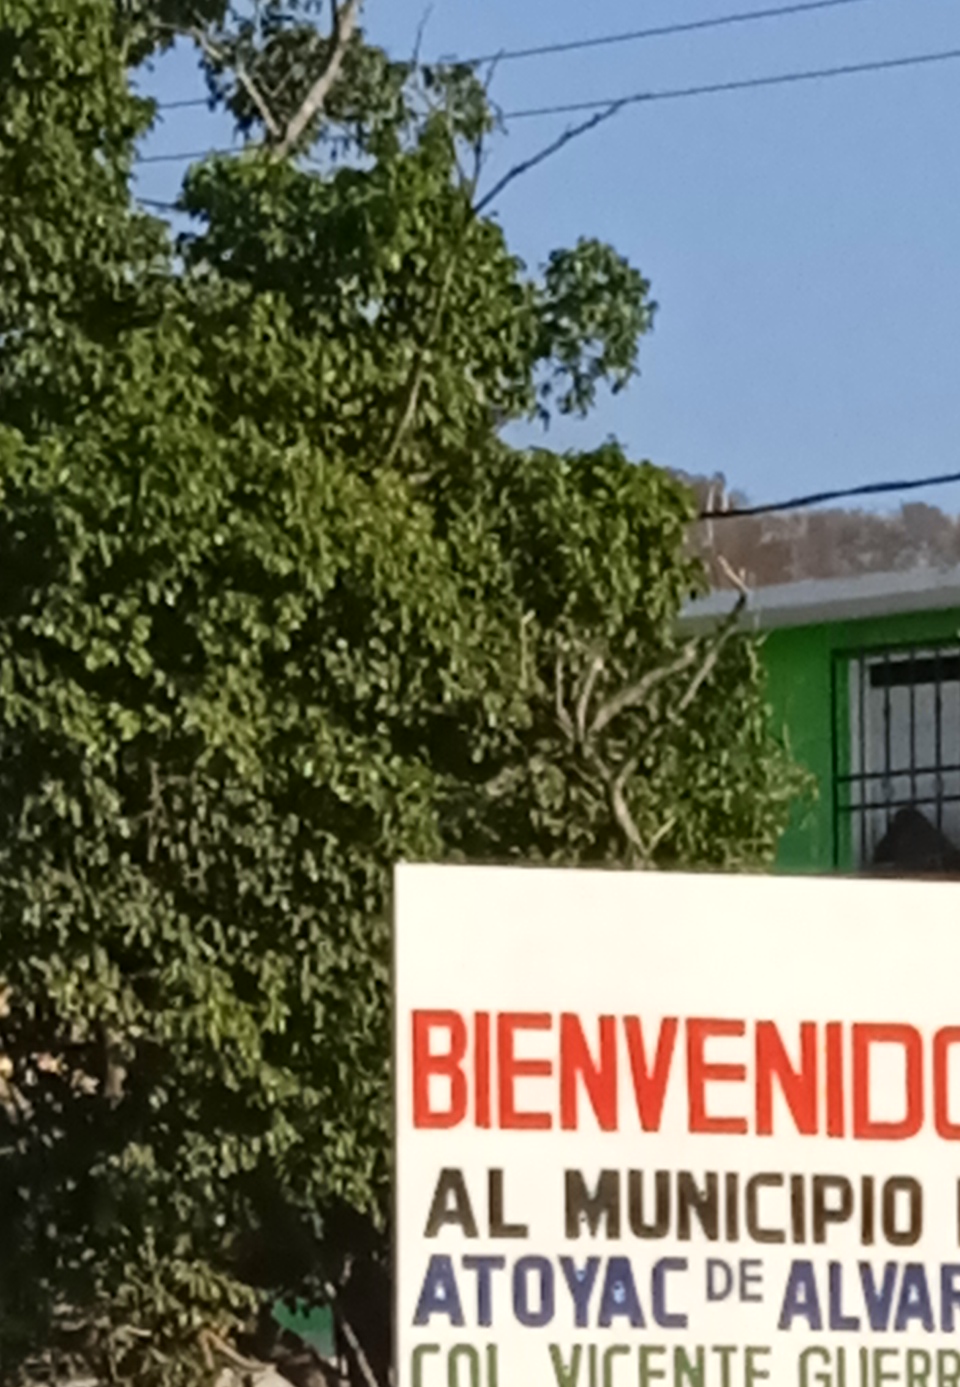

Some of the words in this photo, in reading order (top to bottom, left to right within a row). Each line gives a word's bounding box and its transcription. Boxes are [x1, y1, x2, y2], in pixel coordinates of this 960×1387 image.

[423, 1167, 529, 1239] AL
[564, 1168, 923, 1247] MUNICIPIO
[412, 1254, 688, 1329] ATOYAC
[706, 1258, 763, 1302] DE
